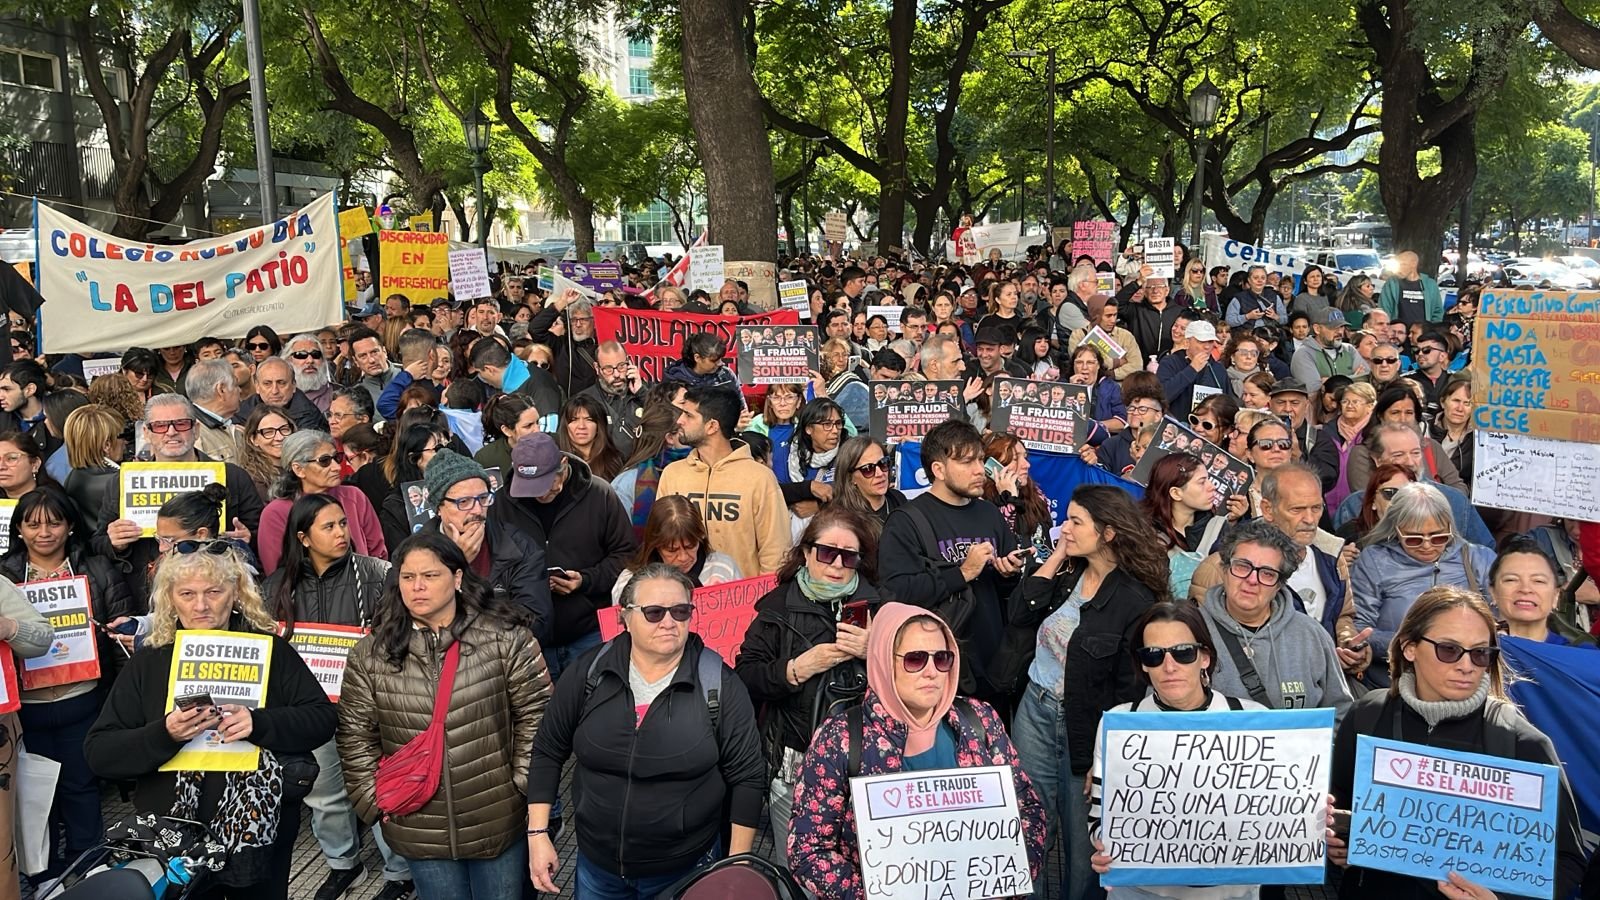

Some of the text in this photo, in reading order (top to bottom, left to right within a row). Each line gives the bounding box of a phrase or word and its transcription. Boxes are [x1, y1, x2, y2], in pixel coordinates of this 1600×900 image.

[380, 231, 448, 245] DISCAPACIDAD
[1149, 240, 1171, 248] BASTA
[402, 252, 425, 265] EN
[382, 276, 448, 290] EMERGENCIA
[149, 280, 216, 313] DEL
[1486, 320, 1522, 342] NO
[753, 348, 806, 357] EL FRAUDE
[1487, 343, 1548, 368] BASTA
[753, 366, 780, 377] SON
[1490, 368, 1552, 390] RESPETE
[888, 404, 948, 414] EL FRAUDE
[1011, 406, 1074, 420] EL FRAUDE
[1044, 418, 1074, 426] PERSONAS
[1474, 405, 1530, 433] CESE
[886, 424, 918, 436] SON
[1007, 425, 1039, 441] SON
[1027, 442, 1053, 450] PROYECTO
[131, 475, 209, 489] EL FRAUDE
[132, 493, 147, 506] ES
[150, 492, 163, 506] EL
[26, 585, 78, 604] BASTA
[48, 613, 87, 629] ELDAD
[296, 635, 308, 644] LEY
[307, 636, 318, 645] DE
[184, 643, 260, 660] SOSTENER
[306, 645, 349, 655] Discapacidad
[181, 662, 259, 682] EL SISTEMA
[183, 684, 251, 696] ES GARANTIZAR
[1281, 681, 1305, 693] AERO
[1122, 733, 1276, 761] EL FRAUDE
[1125, 762, 1183, 789] SON
[1453, 763, 1511, 785] FRAUDE
[934, 776, 978, 792] FRAUDE
[1417, 771, 1515, 801] ES EL AJUSTE
[906, 789, 984, 809] ES EL AJUSTE
[1109, 789, 1143, 814] NO
[1150, 791, 1176, 815] ES
[1182, 791, 1228, 816] UNA
[1398, 796, 1555, 843] DISCAPACIDAD
[1237, 820, 1262, 841] ES
[1265, 817, 1307, 840] UNA
[1359, 815, 1397, 839] NO
[1402, 823, 1485, 855] ESPERA
[1231, 845, 1252, 865] DE
[1250, 839, 1325, 866] ABANDONO
[1352, 838, 1553, 888] Basta de Abandono
